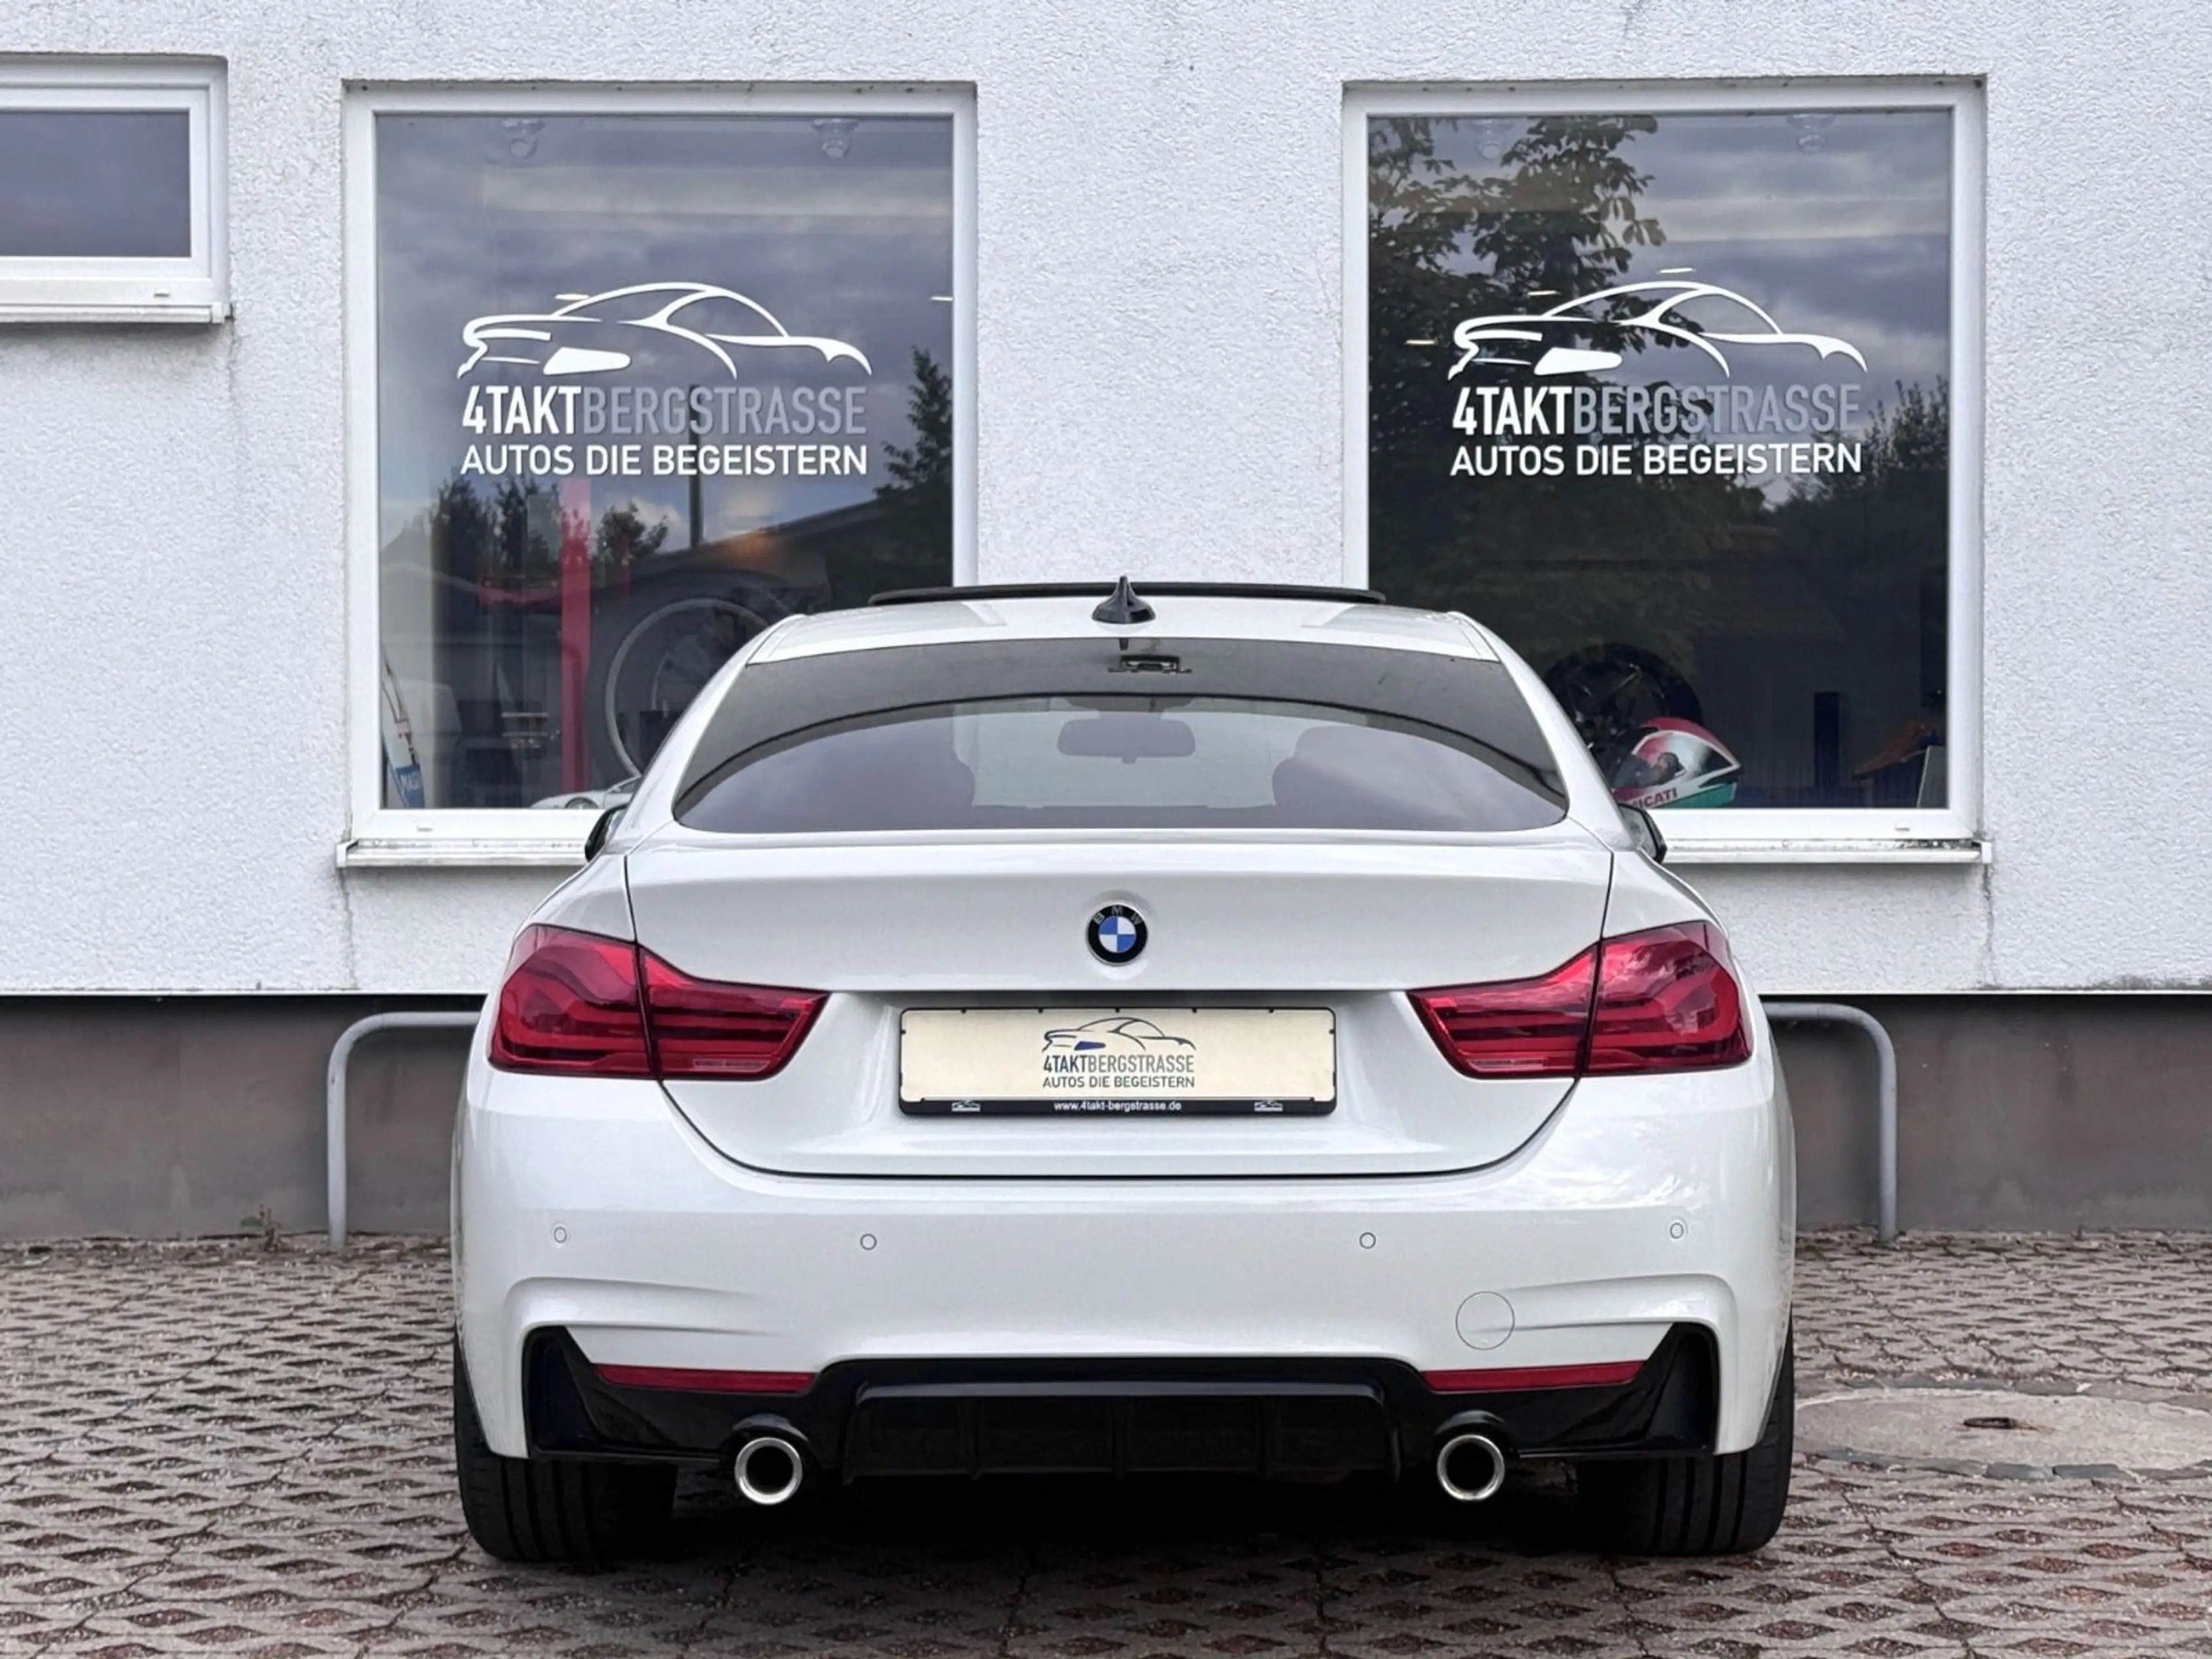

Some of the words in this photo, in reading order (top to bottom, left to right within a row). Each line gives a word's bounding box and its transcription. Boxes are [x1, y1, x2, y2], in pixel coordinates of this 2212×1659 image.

[462, 385, 867, 434] 4TAKTBERGSTRASSE
[1452, 384, 1861, 435] 4TAKTBERGSTRASSE
[460, 445, 574, 475] AUTOS
[586, 445, 642, 475] DIE
[653, 445, 867, 475] BEGEISTERN
[1450, 445, 1565, 475] AUTOS
[1577, 445, 1631, 475] DIE
[1644, 443, 1861, 475] BEGEISTERN
[1093, 906, 1143, 925] BMW
[1043, 1055, 1194, 1073] 4TAKTBERGSTRASSE
[1042, 1075, 1085, 1088] AUTOS
[1089, 1075, 1110, 1088] DIE
[1114, 1075, 1195, 1088] BEGEISTERN
[1054, 1100, 1182, 1112] www.4takt-bergstrasse.de
